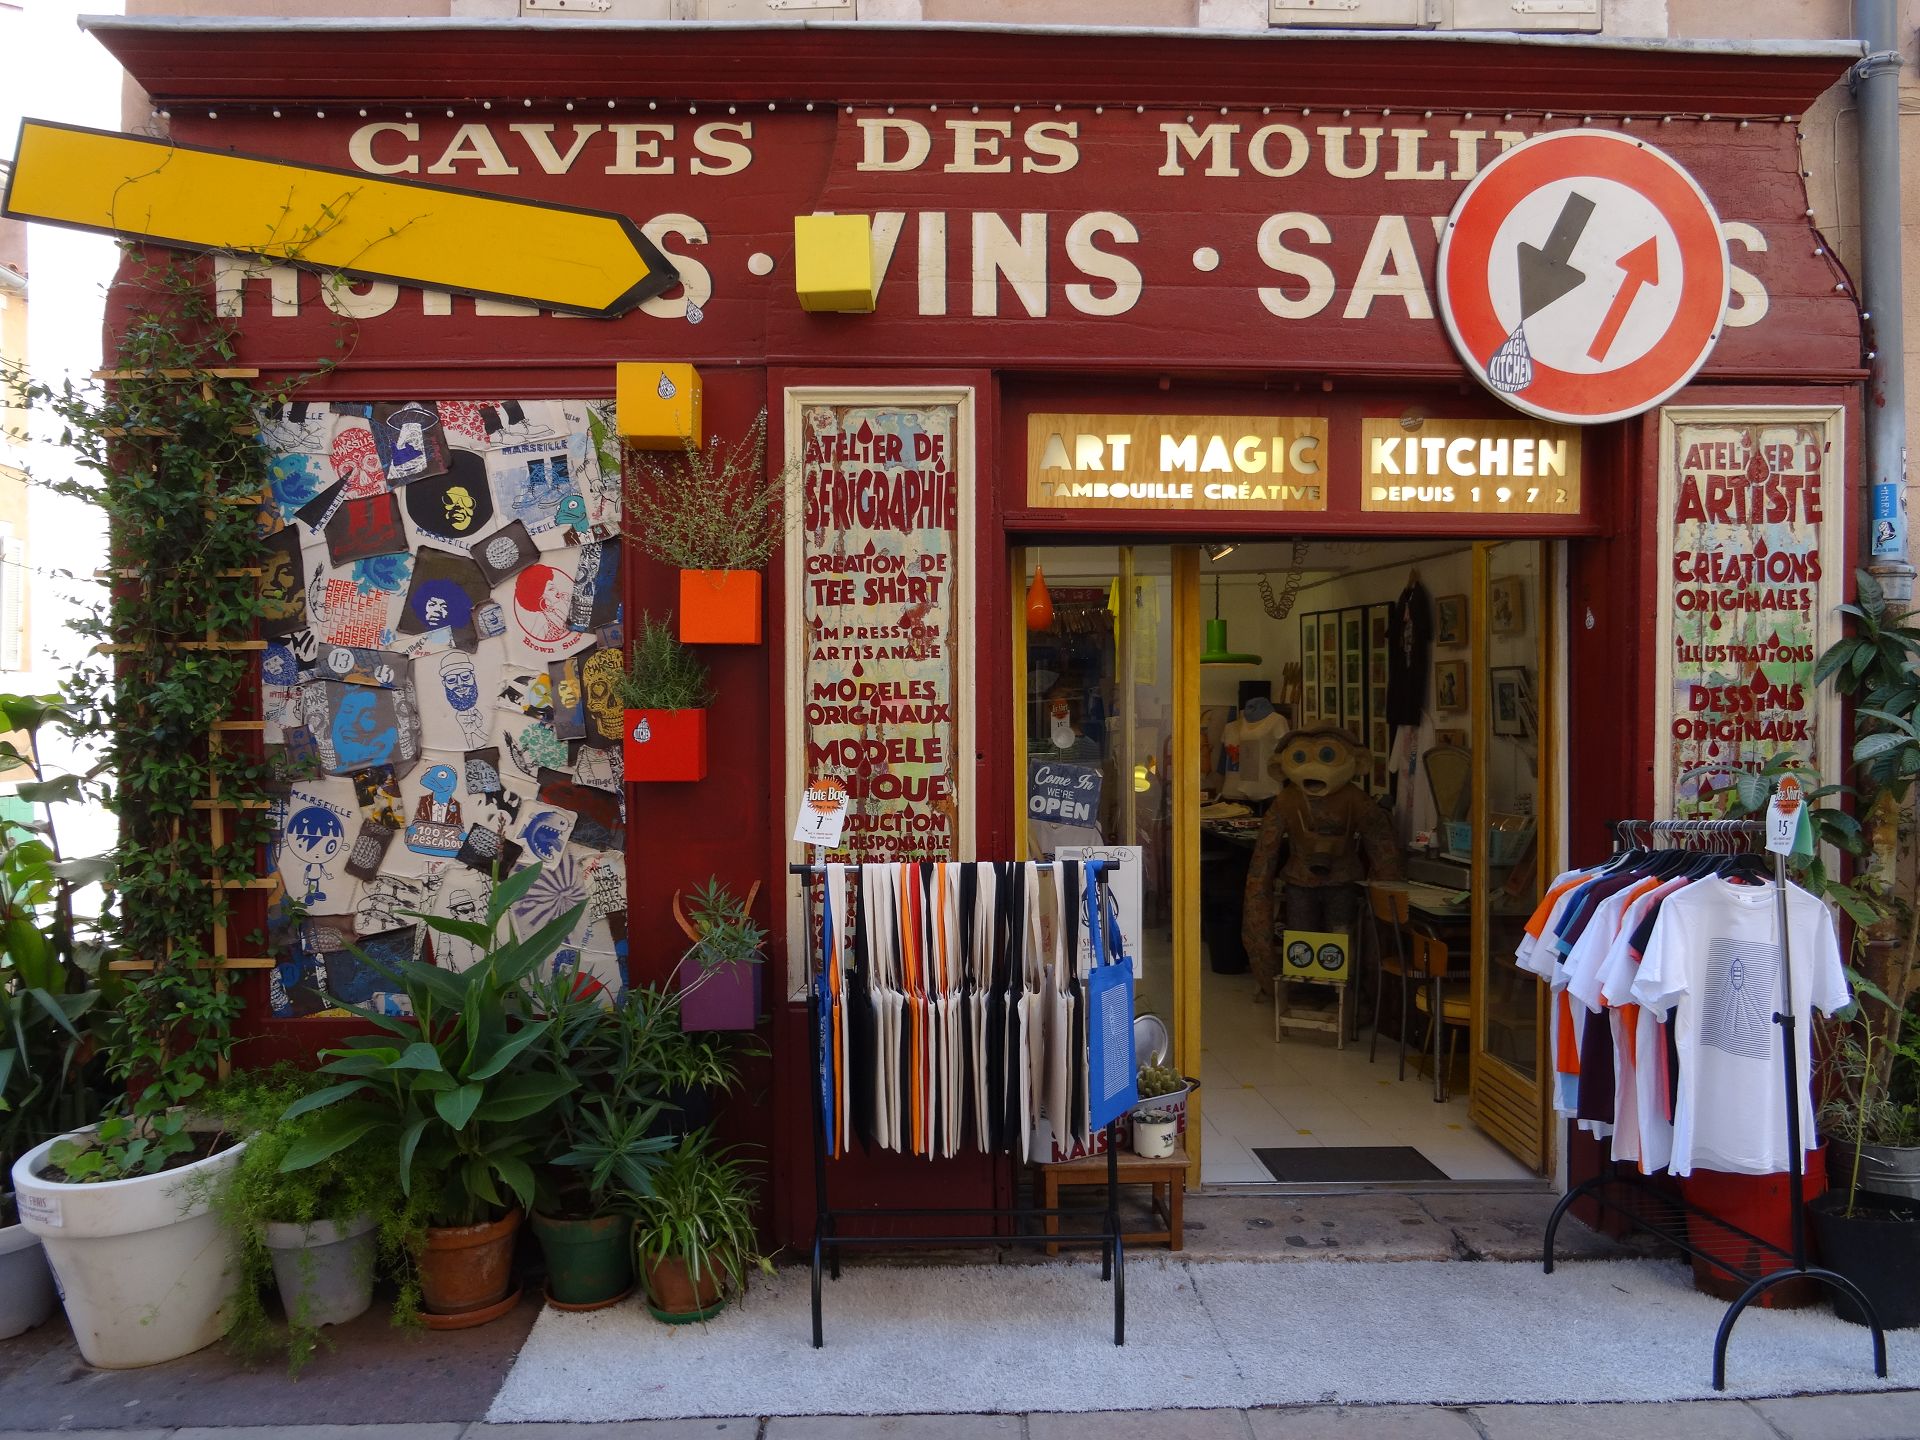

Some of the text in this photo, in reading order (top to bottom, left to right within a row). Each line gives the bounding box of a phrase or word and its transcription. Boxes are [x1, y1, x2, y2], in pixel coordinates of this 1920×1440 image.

[348, 122, 752, 177] CAVES
[857, 119, 1079, 173] DES
[1501, 340, 1527, 357] MAGIC
[1490, 356, 1531, 384] KITCHEN
[501, 440, 568, 455] MARSEILLE
[914, 434, 944, 462] DE
[1040, 433, 1320, 474] ART MAGIC
[1371, 437, 1567, 477] KITCHEN
[1040, 481, 1320, 500] TAMBOUILLE CRÉATIVE
[1371, 486, 1455, 502] DEPUIS
[920, 554, 947, 572] DE
[811, 579, 856, 607] TEE
[523, 636, 554, 653] Brown
[812, 645, 941, 661] ARTISANALE
[332, 653, 350, 668] 13
[813, 679, 937, 702] MODELES
[808, 737, 943, 768] MODELE
[1035, 766, 1095, 791] Come In
[809, 787, 847, 803] Tote Bag
[1047, 787, 1074, 800] WE'RE
[291, 789, 352, 818] MARSEILLE
[1029, 795, 1090, 821] OPEN
[417, 826, 441, 837] 100
[816, 816, 823, 829] 7
[1779, 820, 1788, 836] 15
